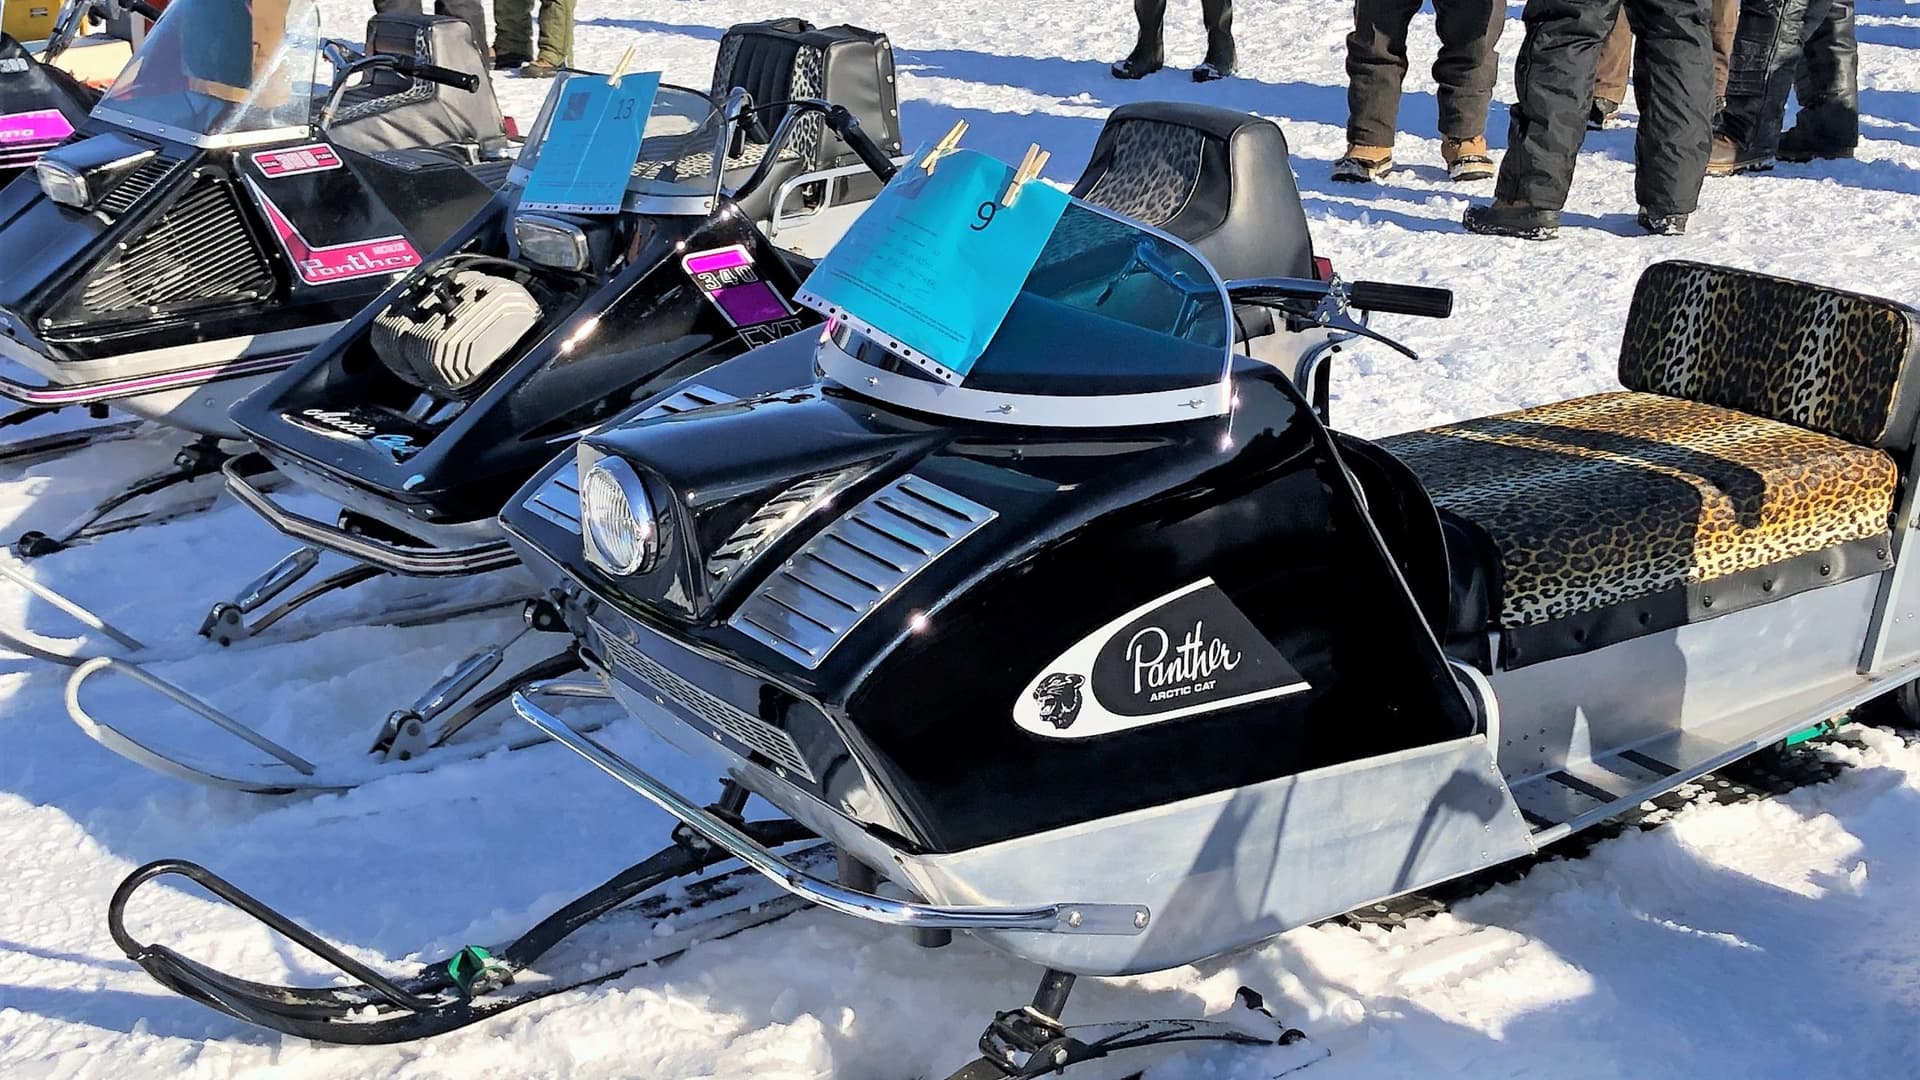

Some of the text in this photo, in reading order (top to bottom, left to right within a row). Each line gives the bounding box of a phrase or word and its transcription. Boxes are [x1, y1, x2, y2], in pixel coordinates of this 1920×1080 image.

[613, 98, 635, 120] 13
[970, 201, 996, 231] 9
[300, 250, 414, 277] Panther
[697, 265, 759, 290] 340
[1126, 620, 1242, 694] Panther
[1149, 679, 1217, 703] ARCTIC CAT
